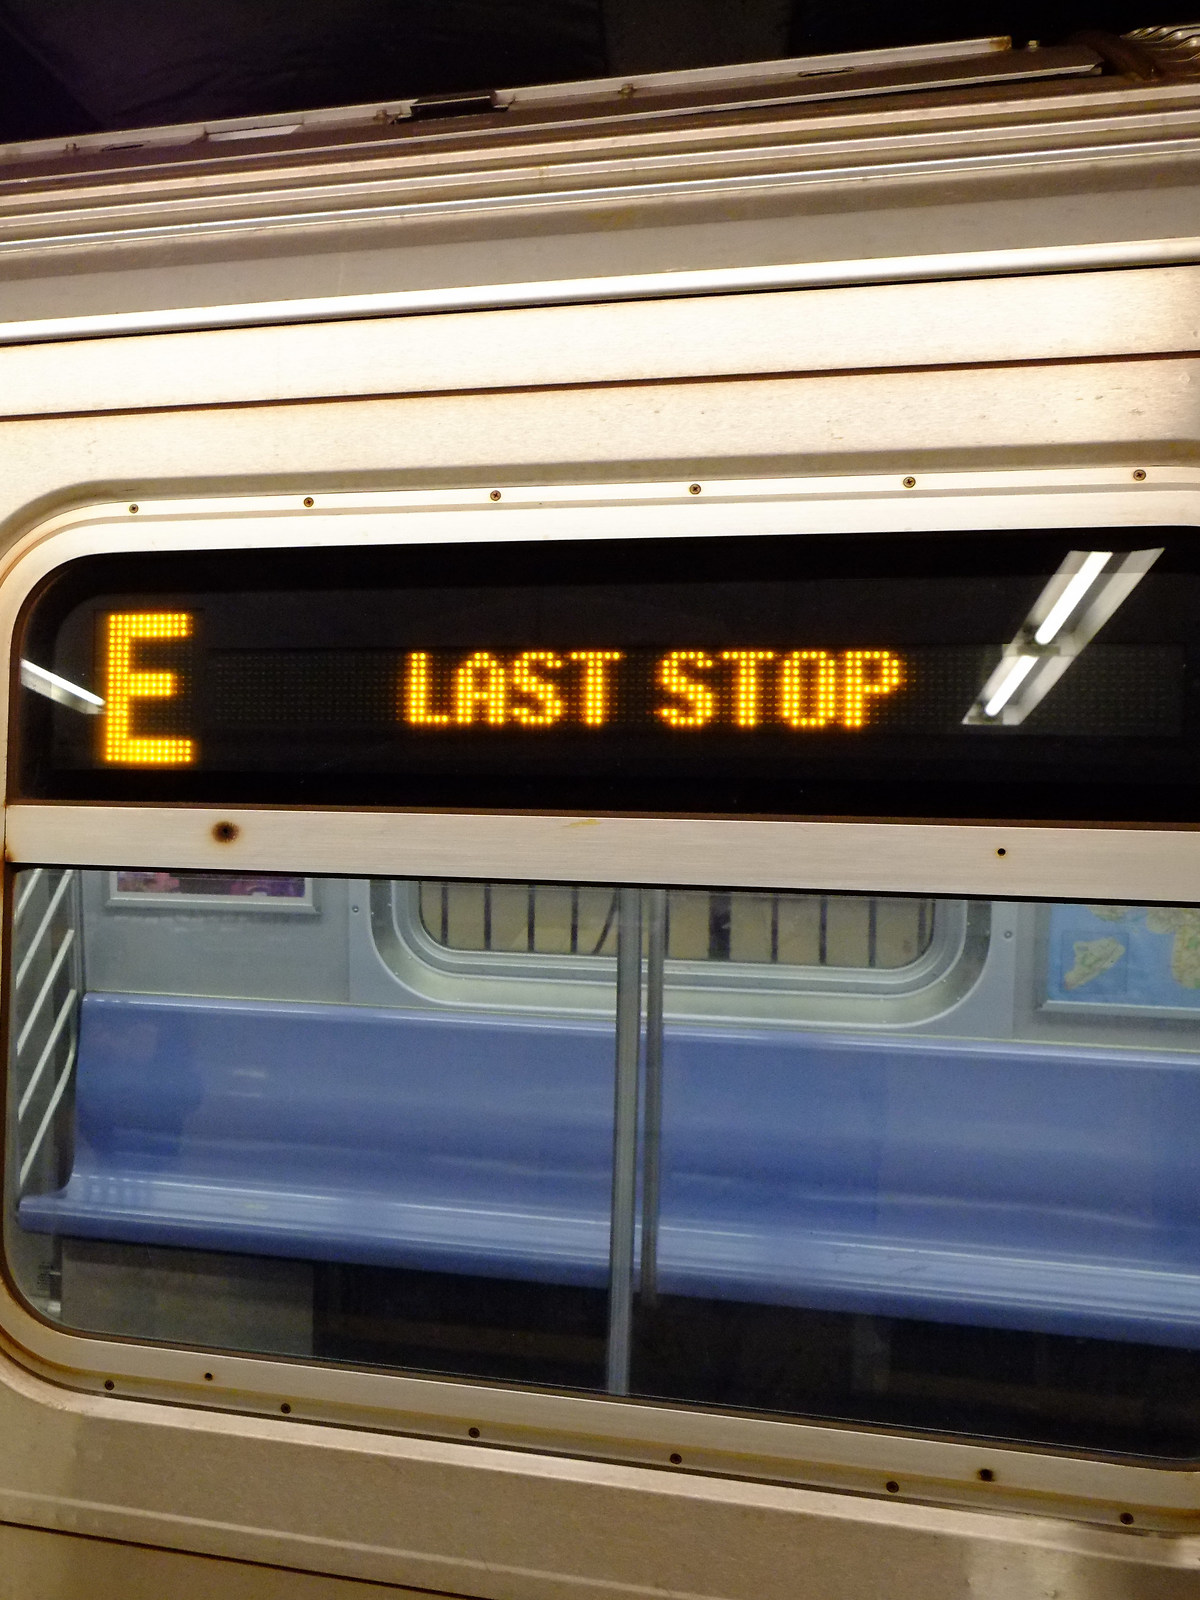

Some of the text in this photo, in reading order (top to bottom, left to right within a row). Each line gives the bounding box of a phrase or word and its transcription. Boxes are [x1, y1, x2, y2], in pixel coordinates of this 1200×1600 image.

[106, 612, 193, 763] E
[410, 650, 901, 727] LAST STOP
